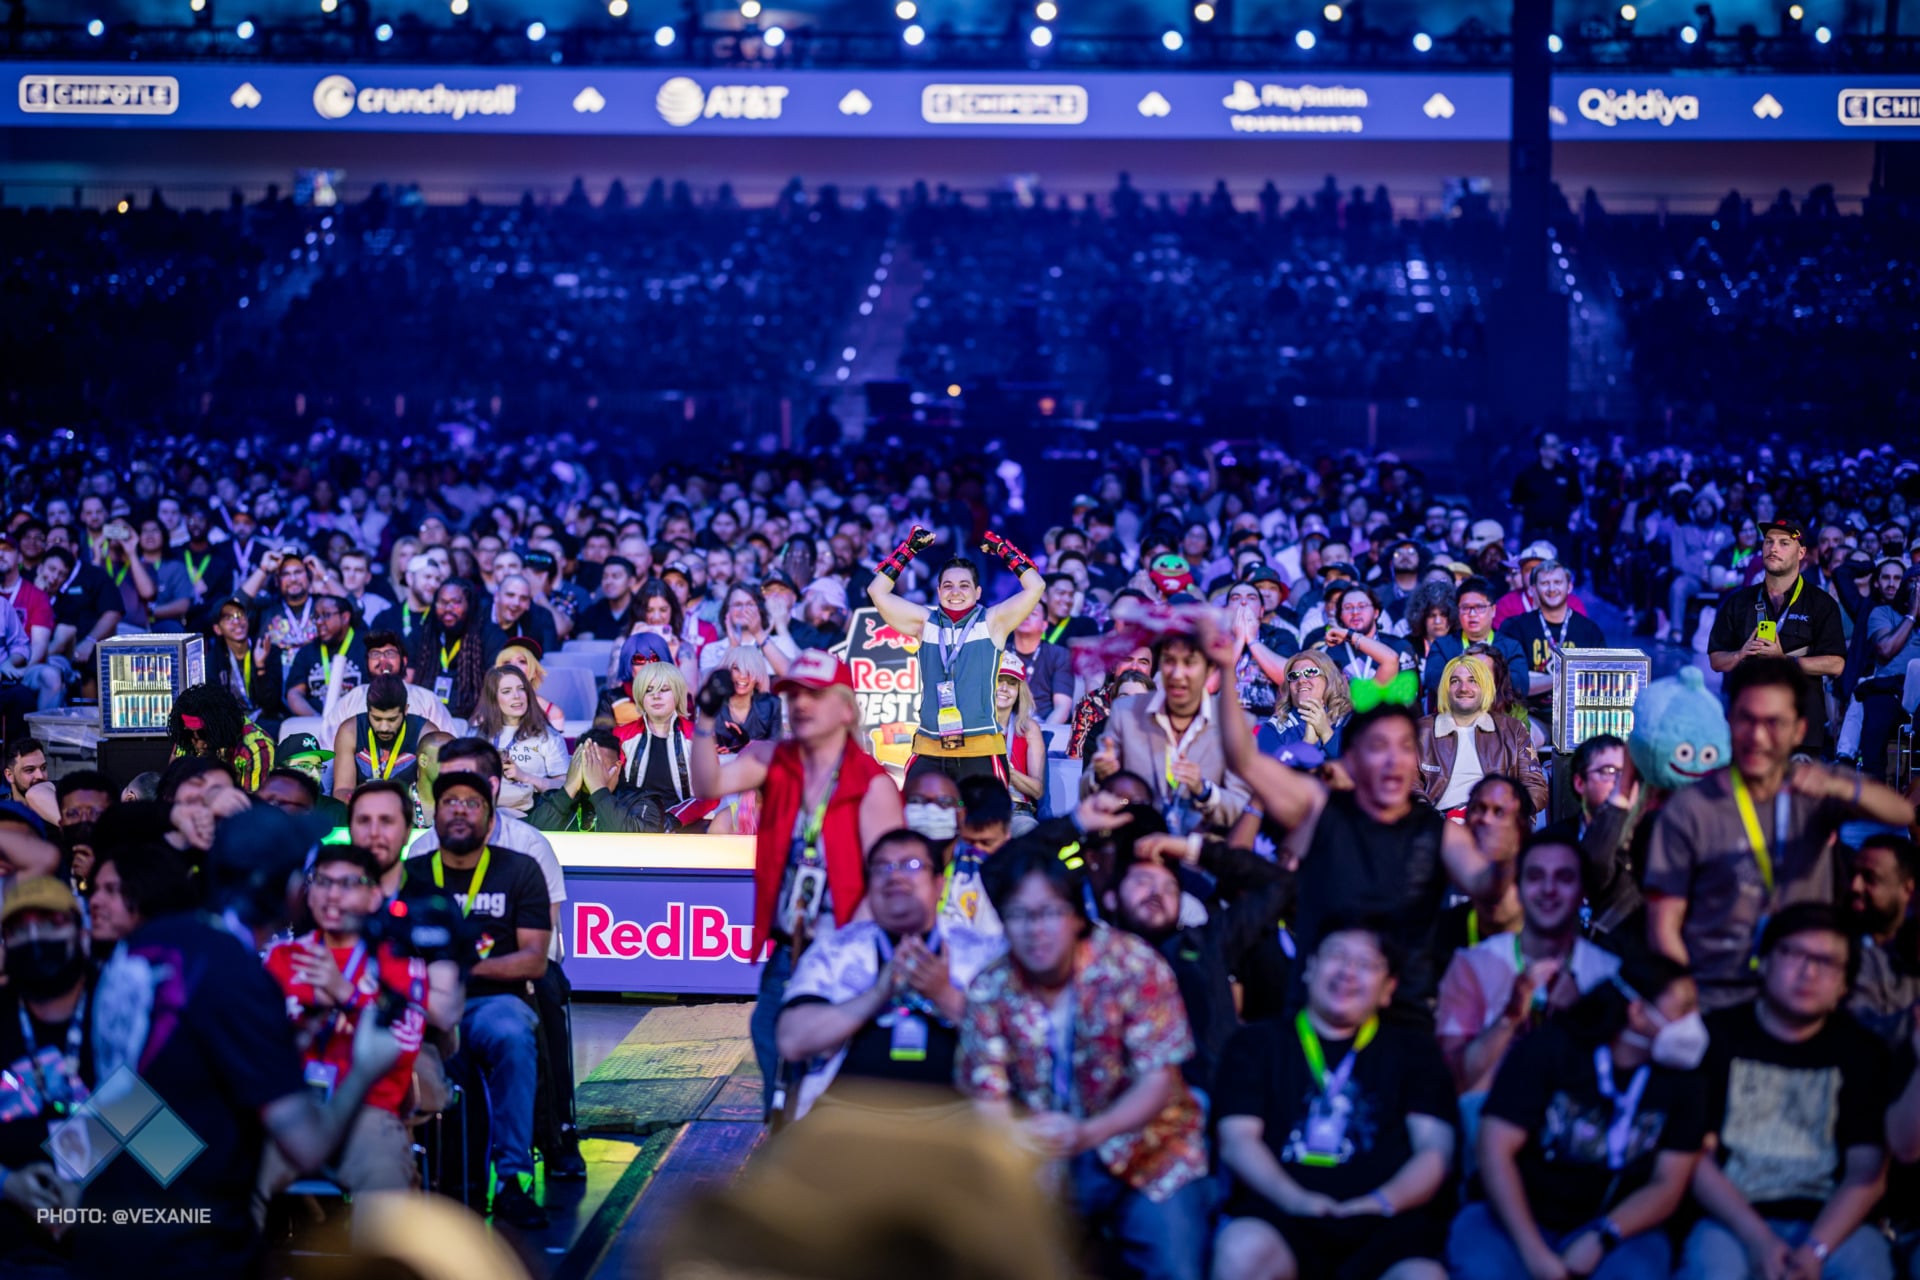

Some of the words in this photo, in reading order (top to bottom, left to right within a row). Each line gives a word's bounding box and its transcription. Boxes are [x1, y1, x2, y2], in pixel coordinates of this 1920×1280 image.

[54, 84, 171, 105] CHIPOTLE
[357, 82, 516, 120] crunchyroll
[704, 85, 789, 119] AT&T
[1578, 87, 1699, 126] Qiddiya
[1874, 97, 1920, 118] CHI
[852, 658, 918, 691] Red
[574, 902, 684, 960] Red
[689, 905, 777, 963] Bu
